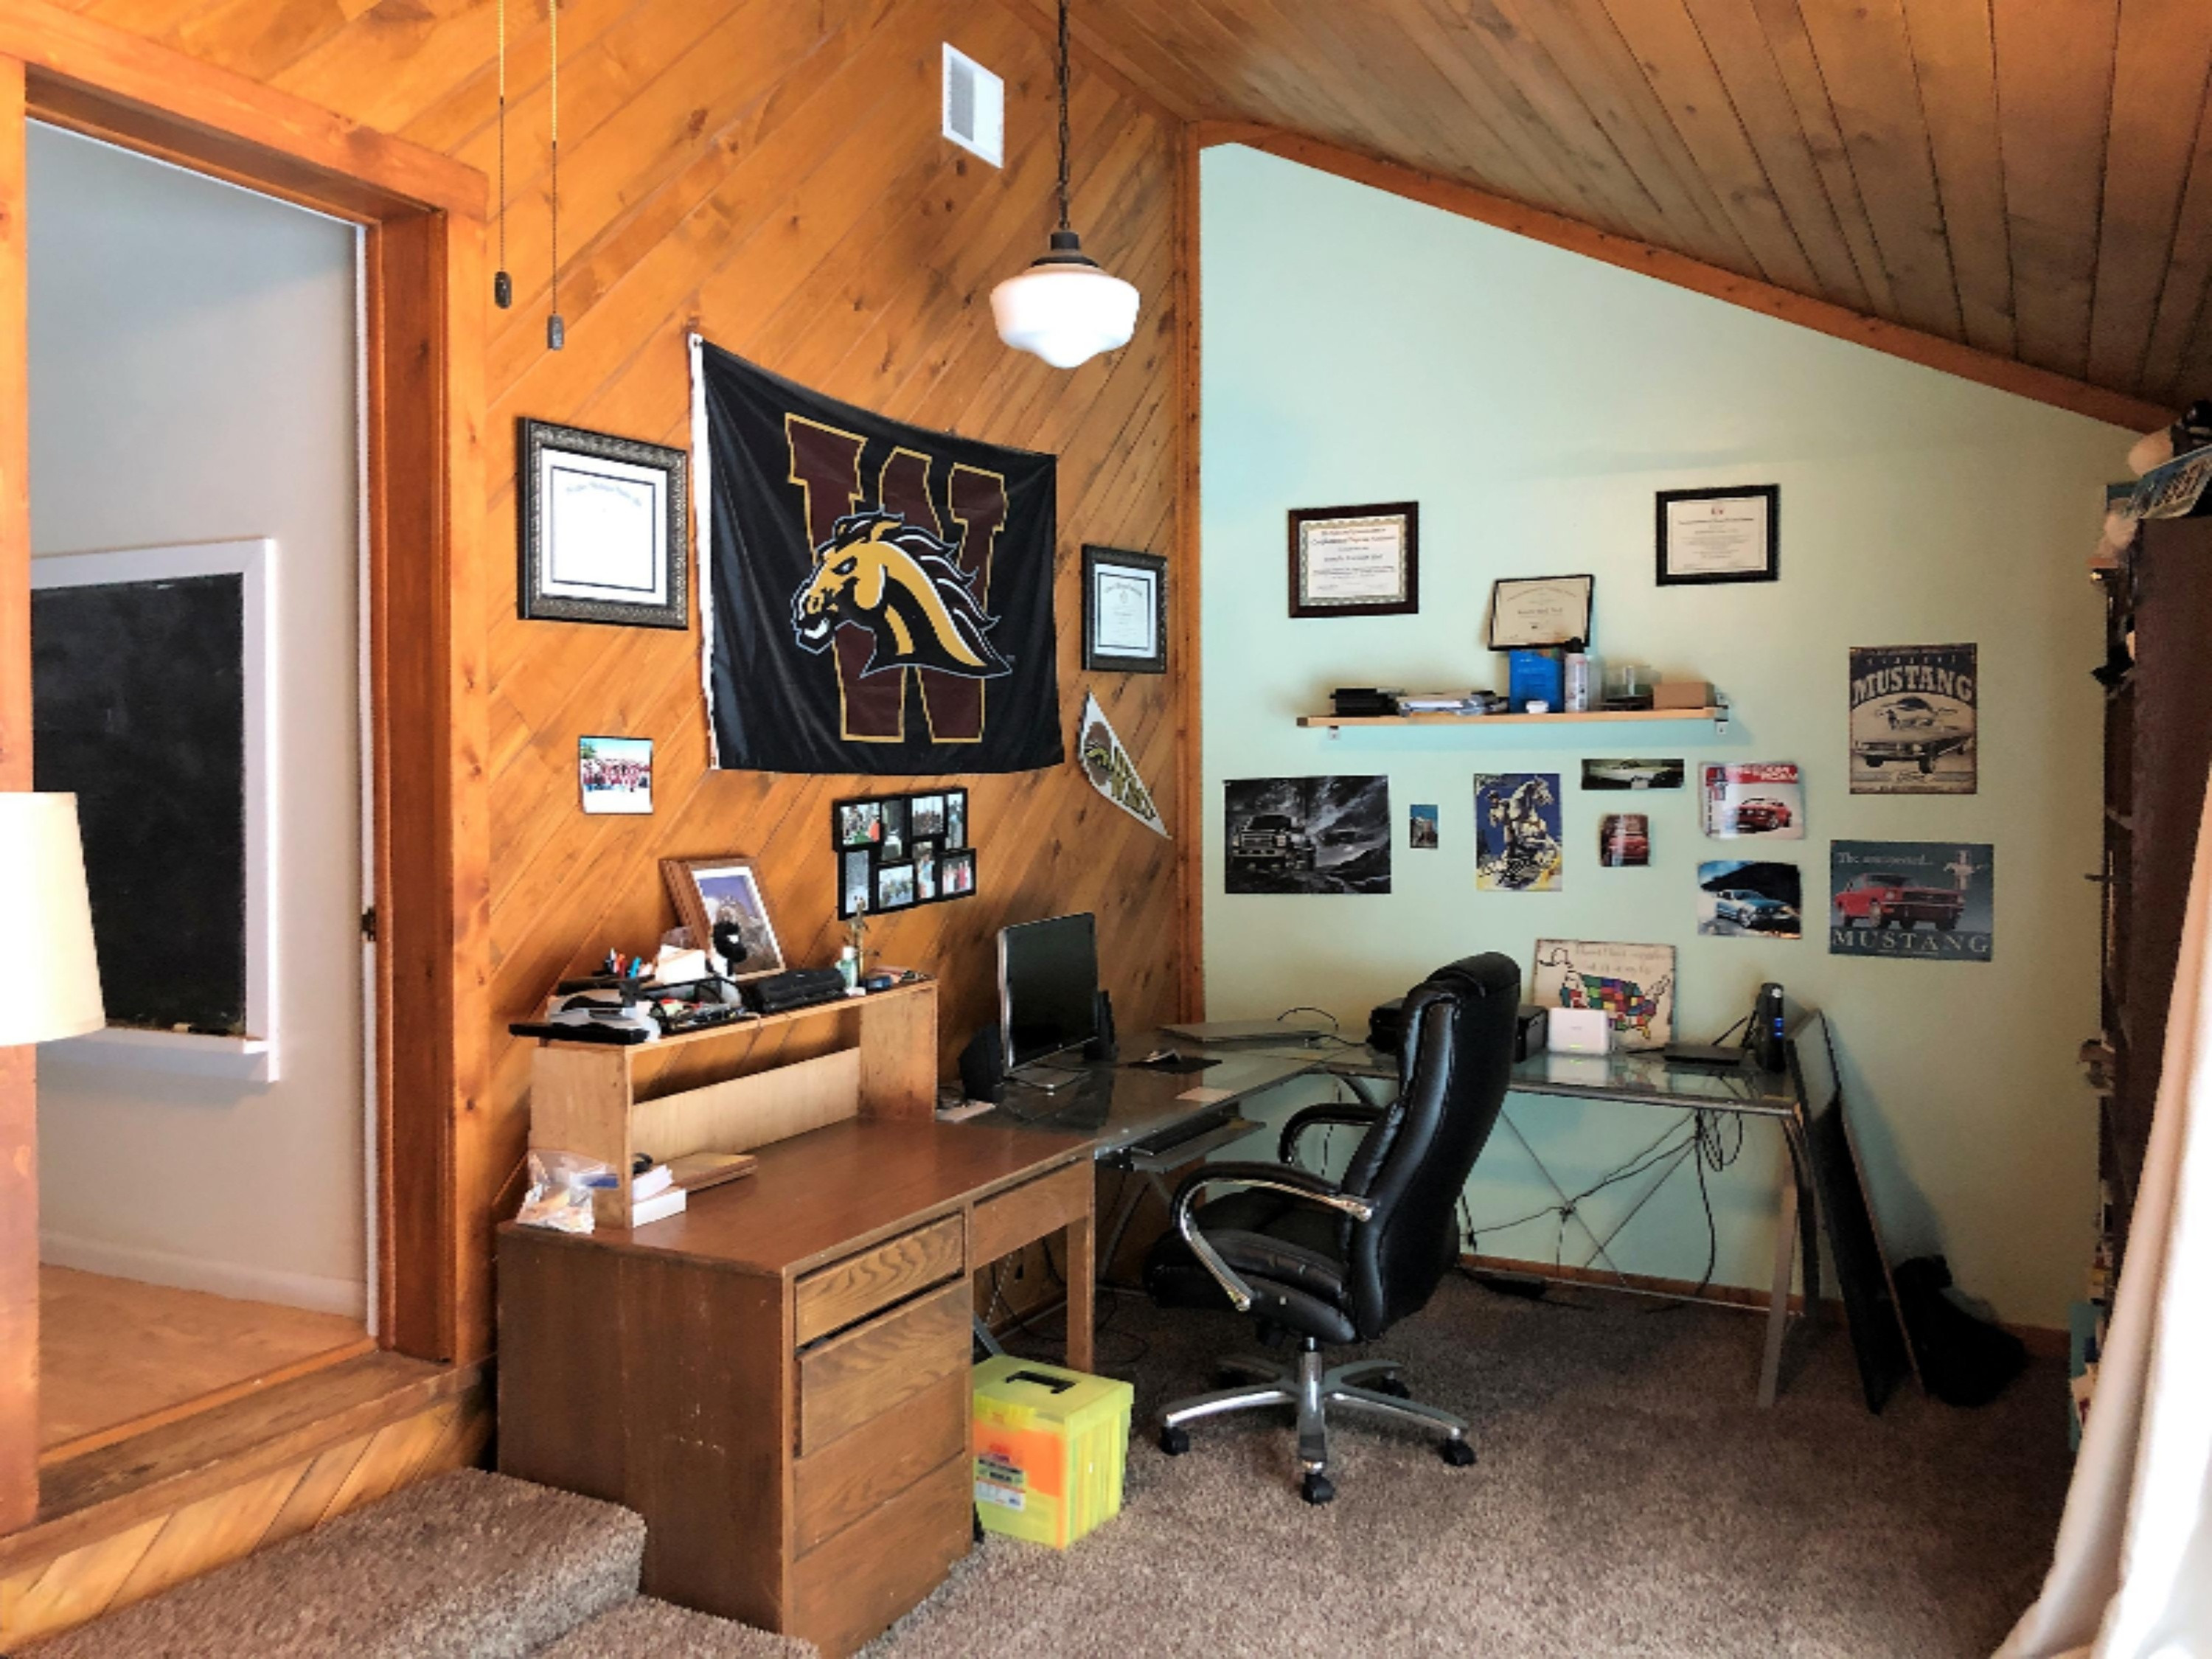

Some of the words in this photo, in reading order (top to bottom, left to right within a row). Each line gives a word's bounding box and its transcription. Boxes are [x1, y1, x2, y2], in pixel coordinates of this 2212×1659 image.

[1851, 665, 1973, 706] MUSTANG
[1837, 852, 1859, 864] The
[1833, 930, 1989, 953] MUSTANG
